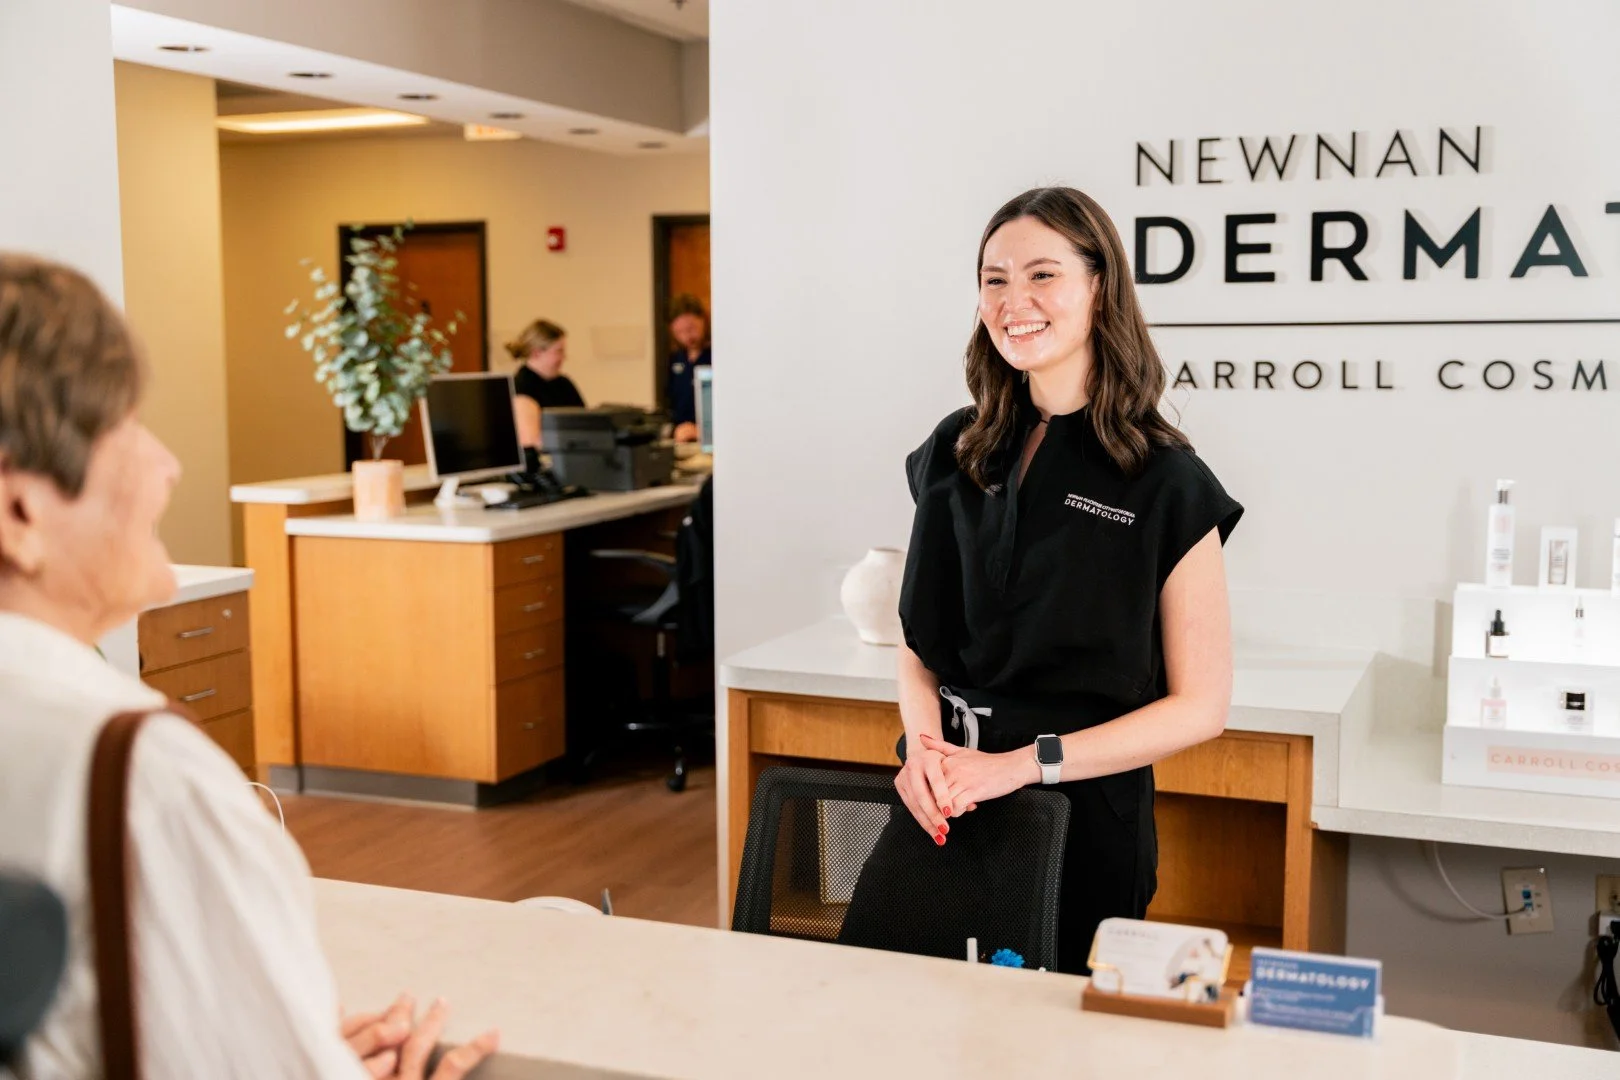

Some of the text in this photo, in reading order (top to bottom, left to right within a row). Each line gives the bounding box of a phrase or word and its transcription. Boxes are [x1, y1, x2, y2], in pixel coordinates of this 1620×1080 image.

[1136, 126, 1482, 187] NEWNAN
[1172, 360, 1395, 391] ARROLL
[1064, 498, 1135, 526] DERMATOLOGY
[1491, 753, 1578, 770] CARROLL
[1255, 966, 1370, 991] DERMATOLOGY
